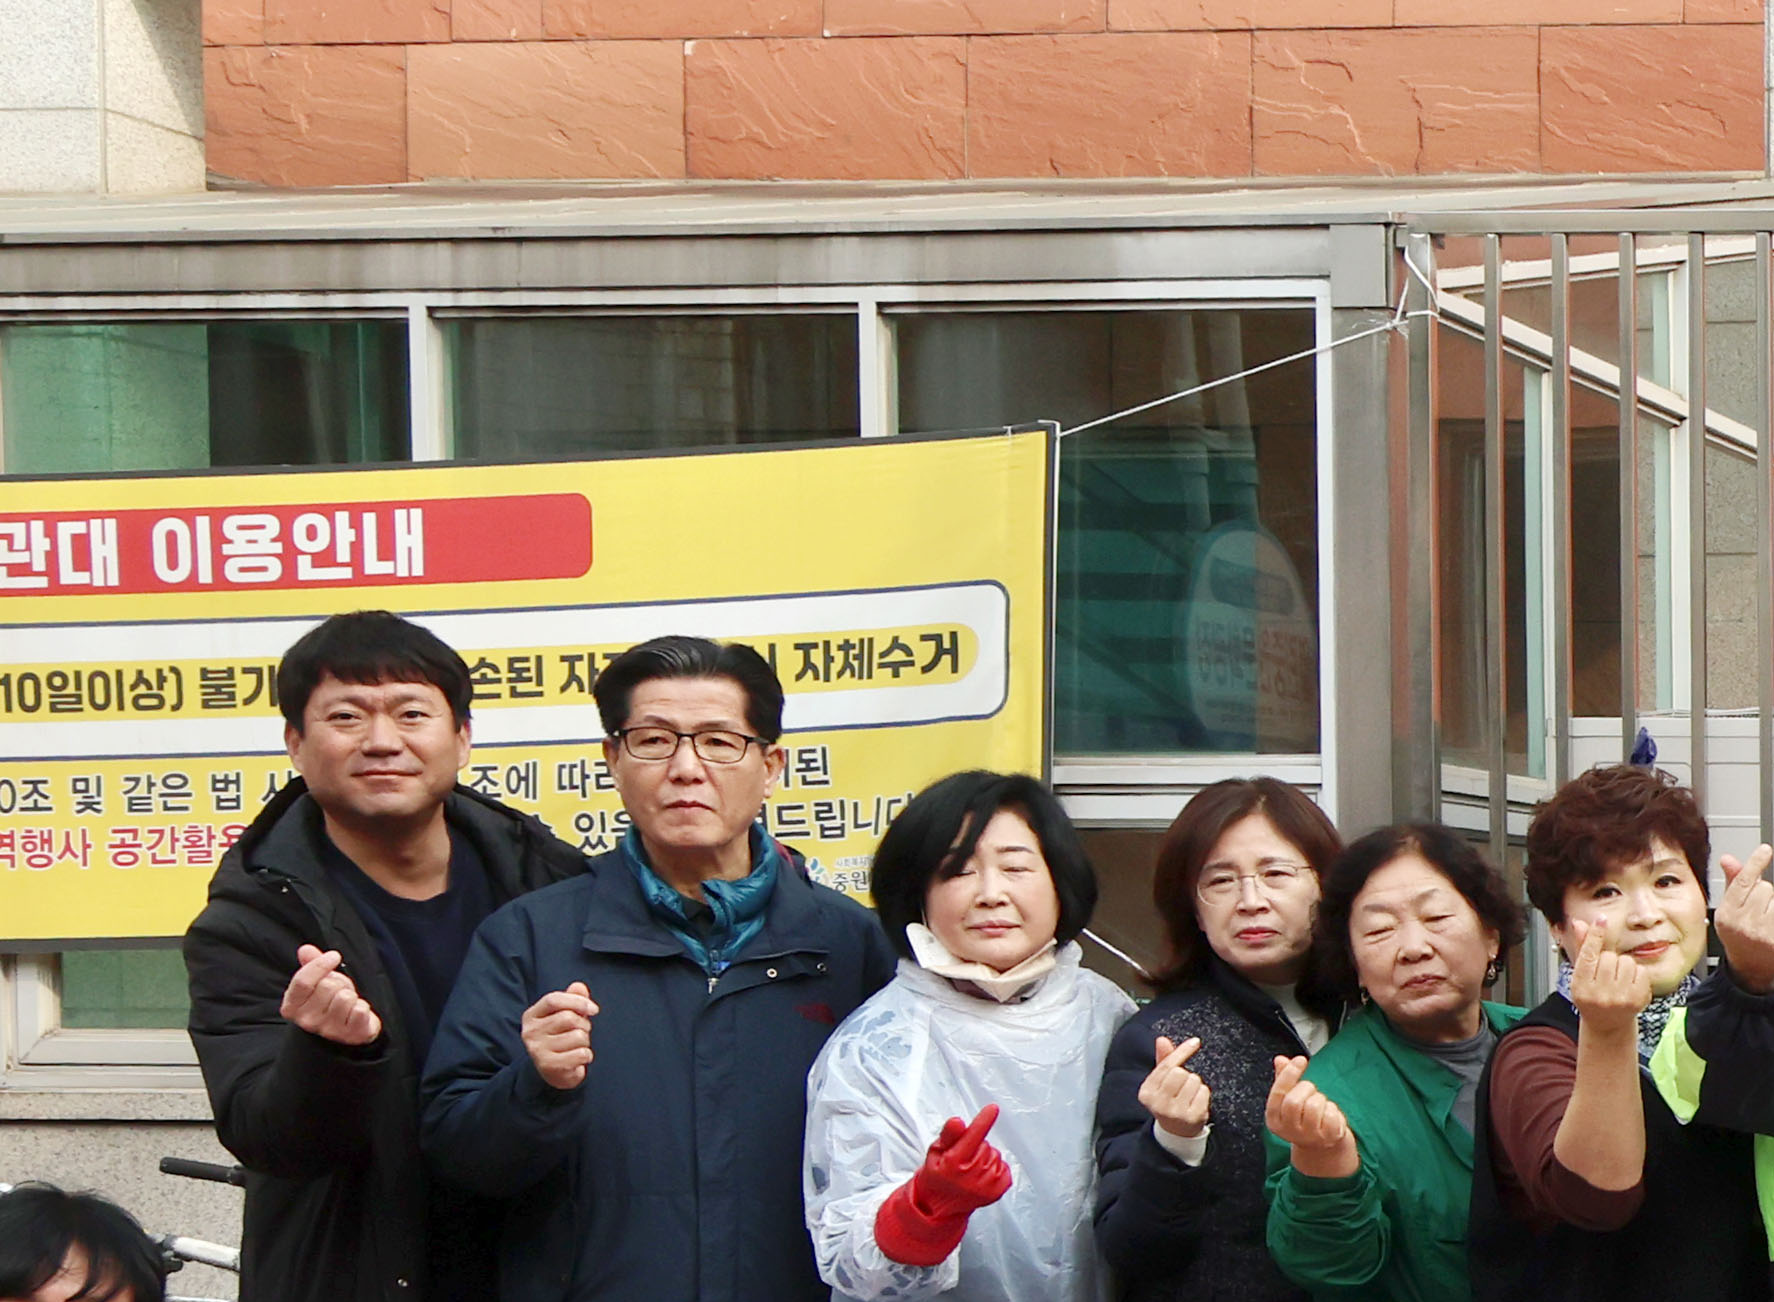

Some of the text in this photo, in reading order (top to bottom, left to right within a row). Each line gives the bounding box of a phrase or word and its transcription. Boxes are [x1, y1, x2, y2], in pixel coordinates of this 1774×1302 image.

[151, 508, 424, 585] 이용안내
[793, 630, 959, 683] 자체수거
[72, 775, 103, 814] 및
[122, 773, 193, 814] 같은
[211, 772, 241, 811] 법
